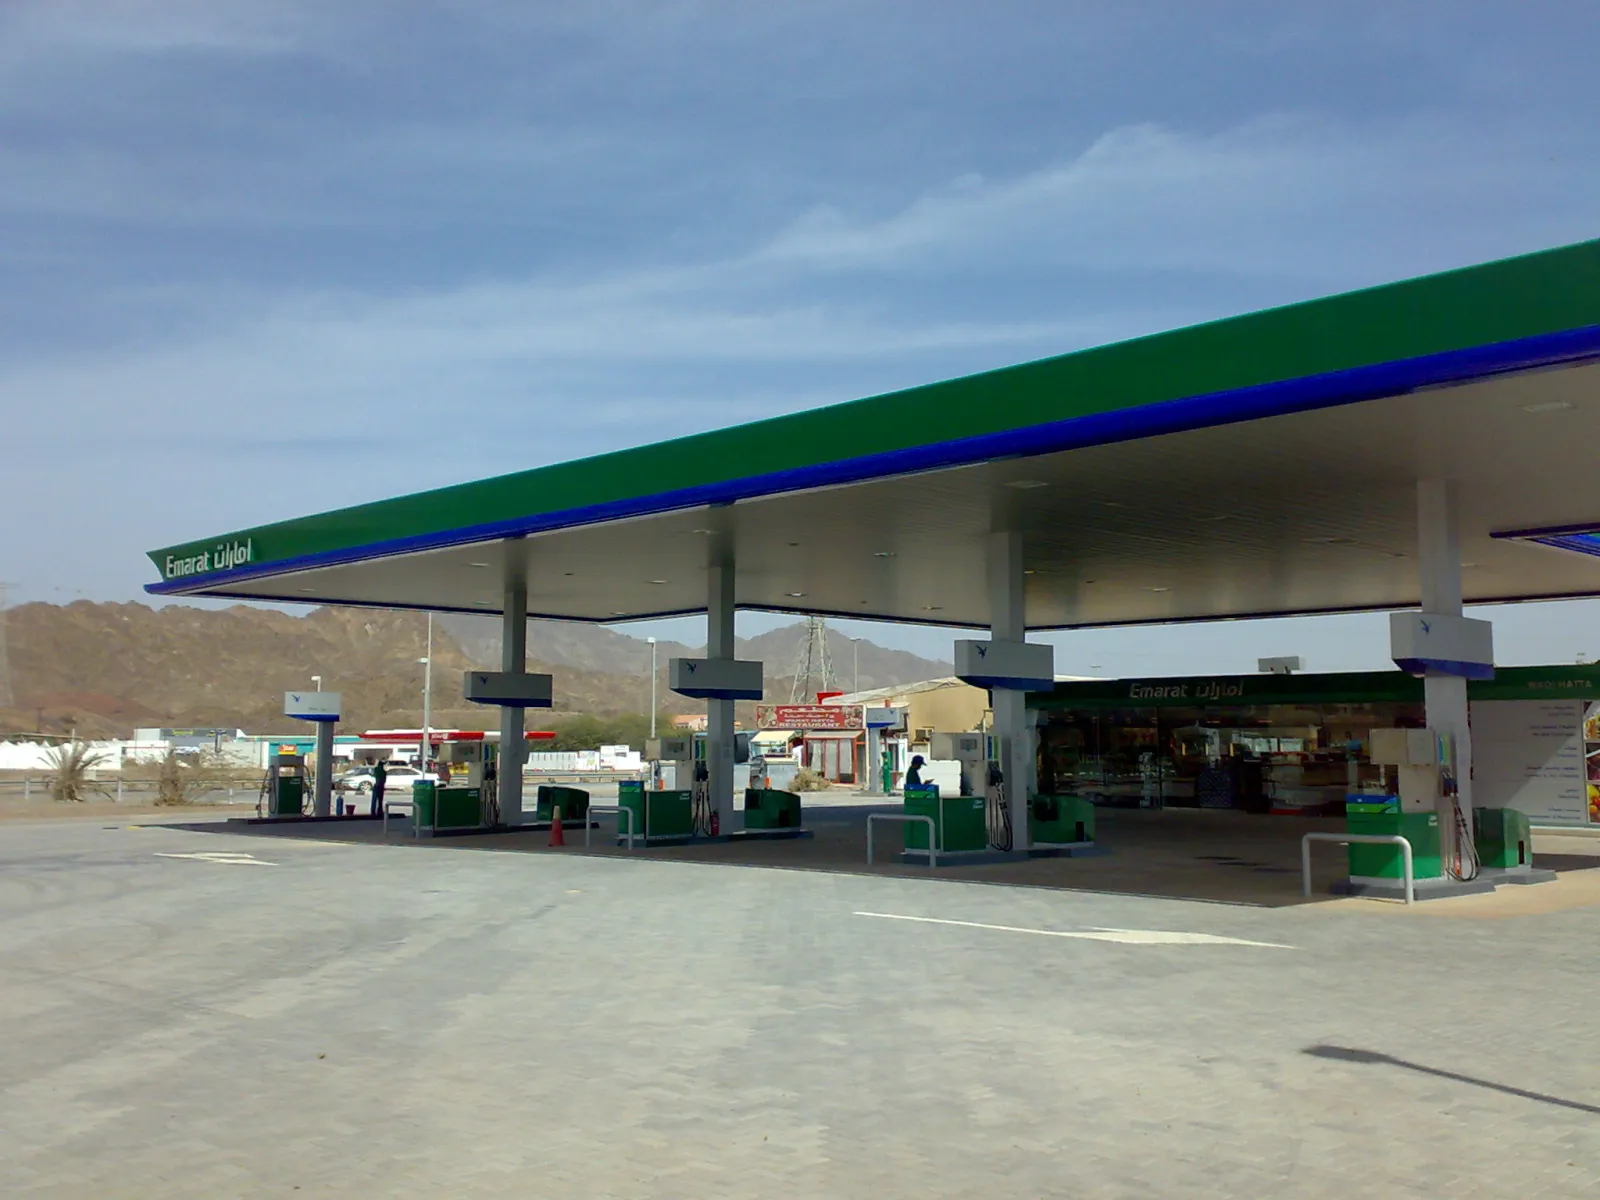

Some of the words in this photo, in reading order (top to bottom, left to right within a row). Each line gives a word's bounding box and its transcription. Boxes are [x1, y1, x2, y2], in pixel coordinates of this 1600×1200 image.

[166, 551, 209, 578] Emarat
[1129, 683, 1189, 699] Emarat
[1558, 680, 1593, 688] HATTA
